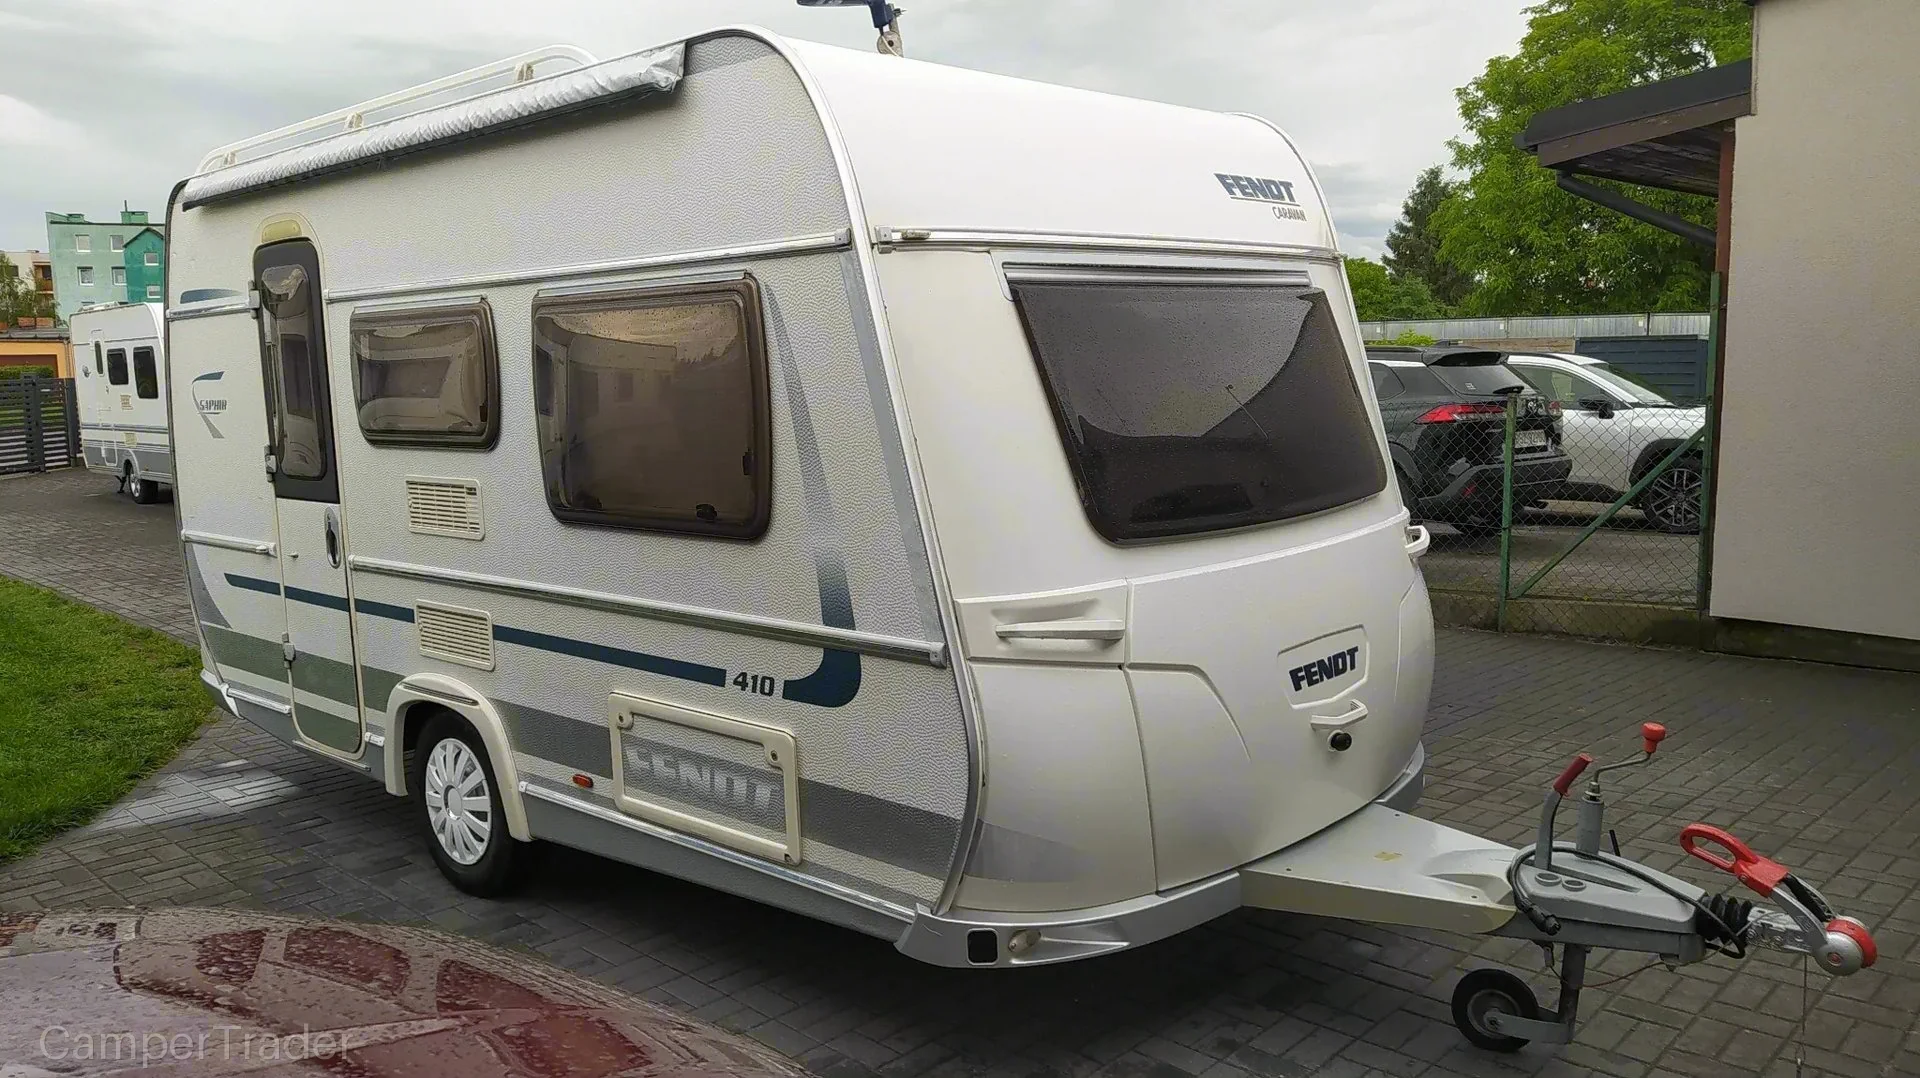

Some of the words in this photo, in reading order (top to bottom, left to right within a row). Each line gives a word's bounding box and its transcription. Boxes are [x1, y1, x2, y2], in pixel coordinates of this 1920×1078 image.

[1213, 173, 1296, 202] FENDT
[1272, 206, 1307, 221] CARAVAN
[200, 400, 227, 411] SAPHIR
[1289, 646, 1359, 692] FENDT
[733, 672, 775, 697] 410
[626, 747, 779, 812] FENDT
